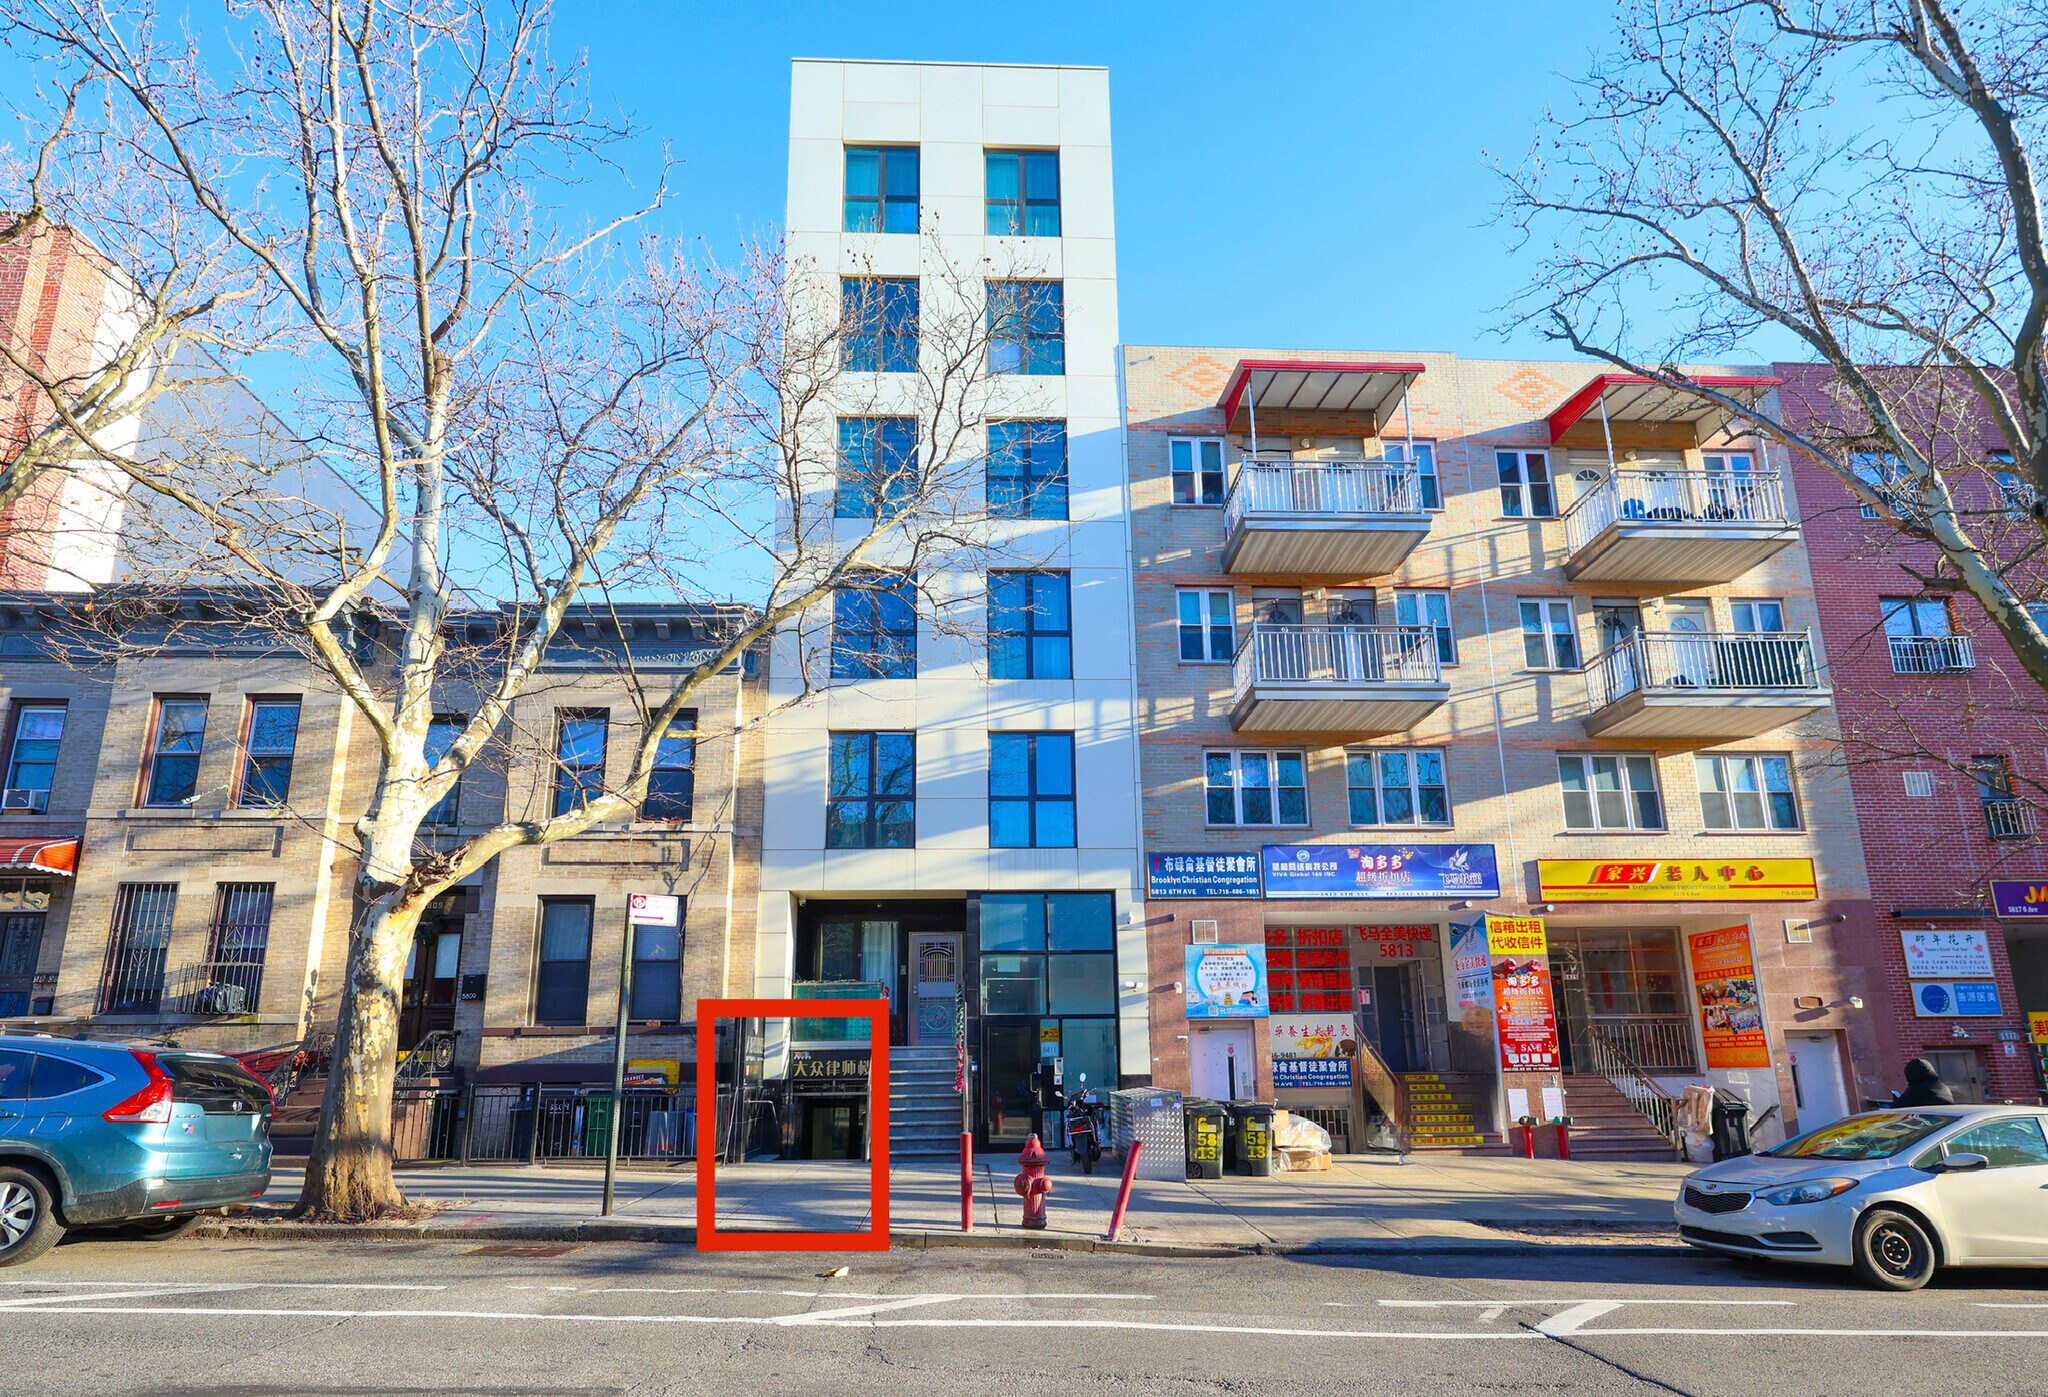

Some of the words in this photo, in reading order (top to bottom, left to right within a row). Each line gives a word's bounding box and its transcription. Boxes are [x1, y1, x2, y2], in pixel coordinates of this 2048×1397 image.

[1151, 876, 1181, 885] Brooklyn
[1213, 876, 1257, 885] Congregation
[1356, 871, 1411, 882] 超级折扣店
[1354, 926, 1433, 941] 飞马全美快递
[1490, 921, 1542, 934] 信箱出租
[1297, 928, 1343, 946] 折扣店
[1491, 937, 1543, 949] 代收信件
[1379, 944, 1414, 957] 5813
[1521, 1043, 1542, 1053] SALE
[794, 1060, 870, 1077] 大众律师楼
[1198, 1133, 1217, 1146] 58
[1247, 1132, 1267, 1145] 58
[1196, 1147, 1217, 1160] 13
[1248, 1146, 1266, 1159] 13
